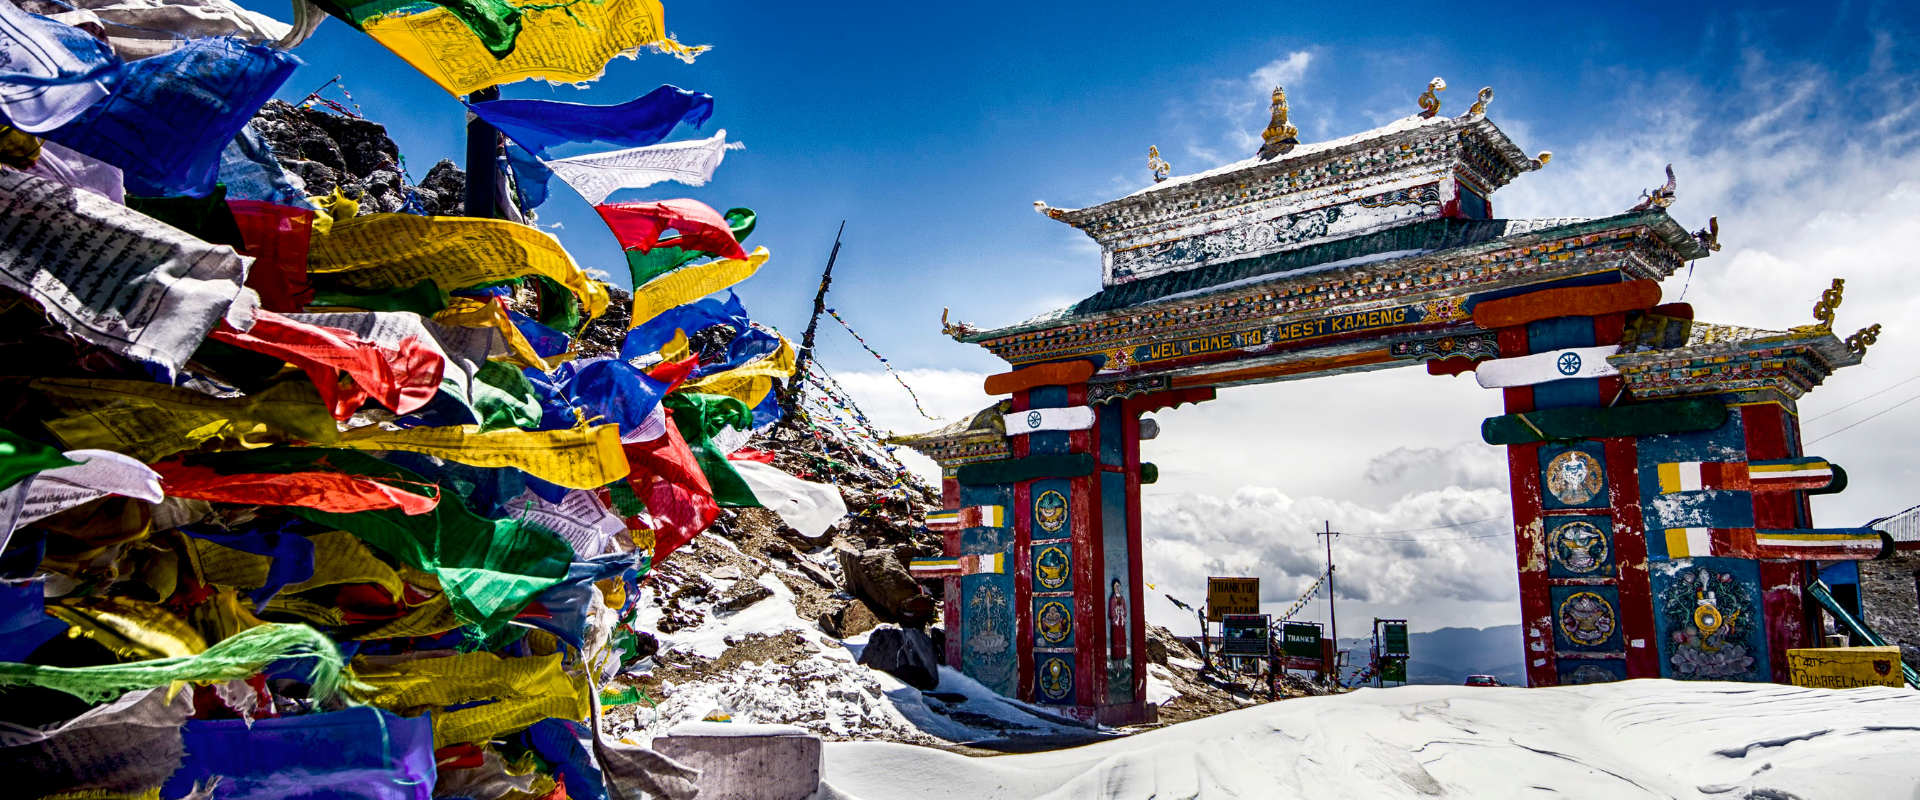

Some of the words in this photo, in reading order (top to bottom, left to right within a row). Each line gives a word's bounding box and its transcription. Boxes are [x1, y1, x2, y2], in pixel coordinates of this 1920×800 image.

[1241, 330, 1262, 345] TO
[1278, 319, 1326, 340] WEST
[1331, 308, 1405, 332] KAMENG
[1287, 634, 1315, 643] THANKS
